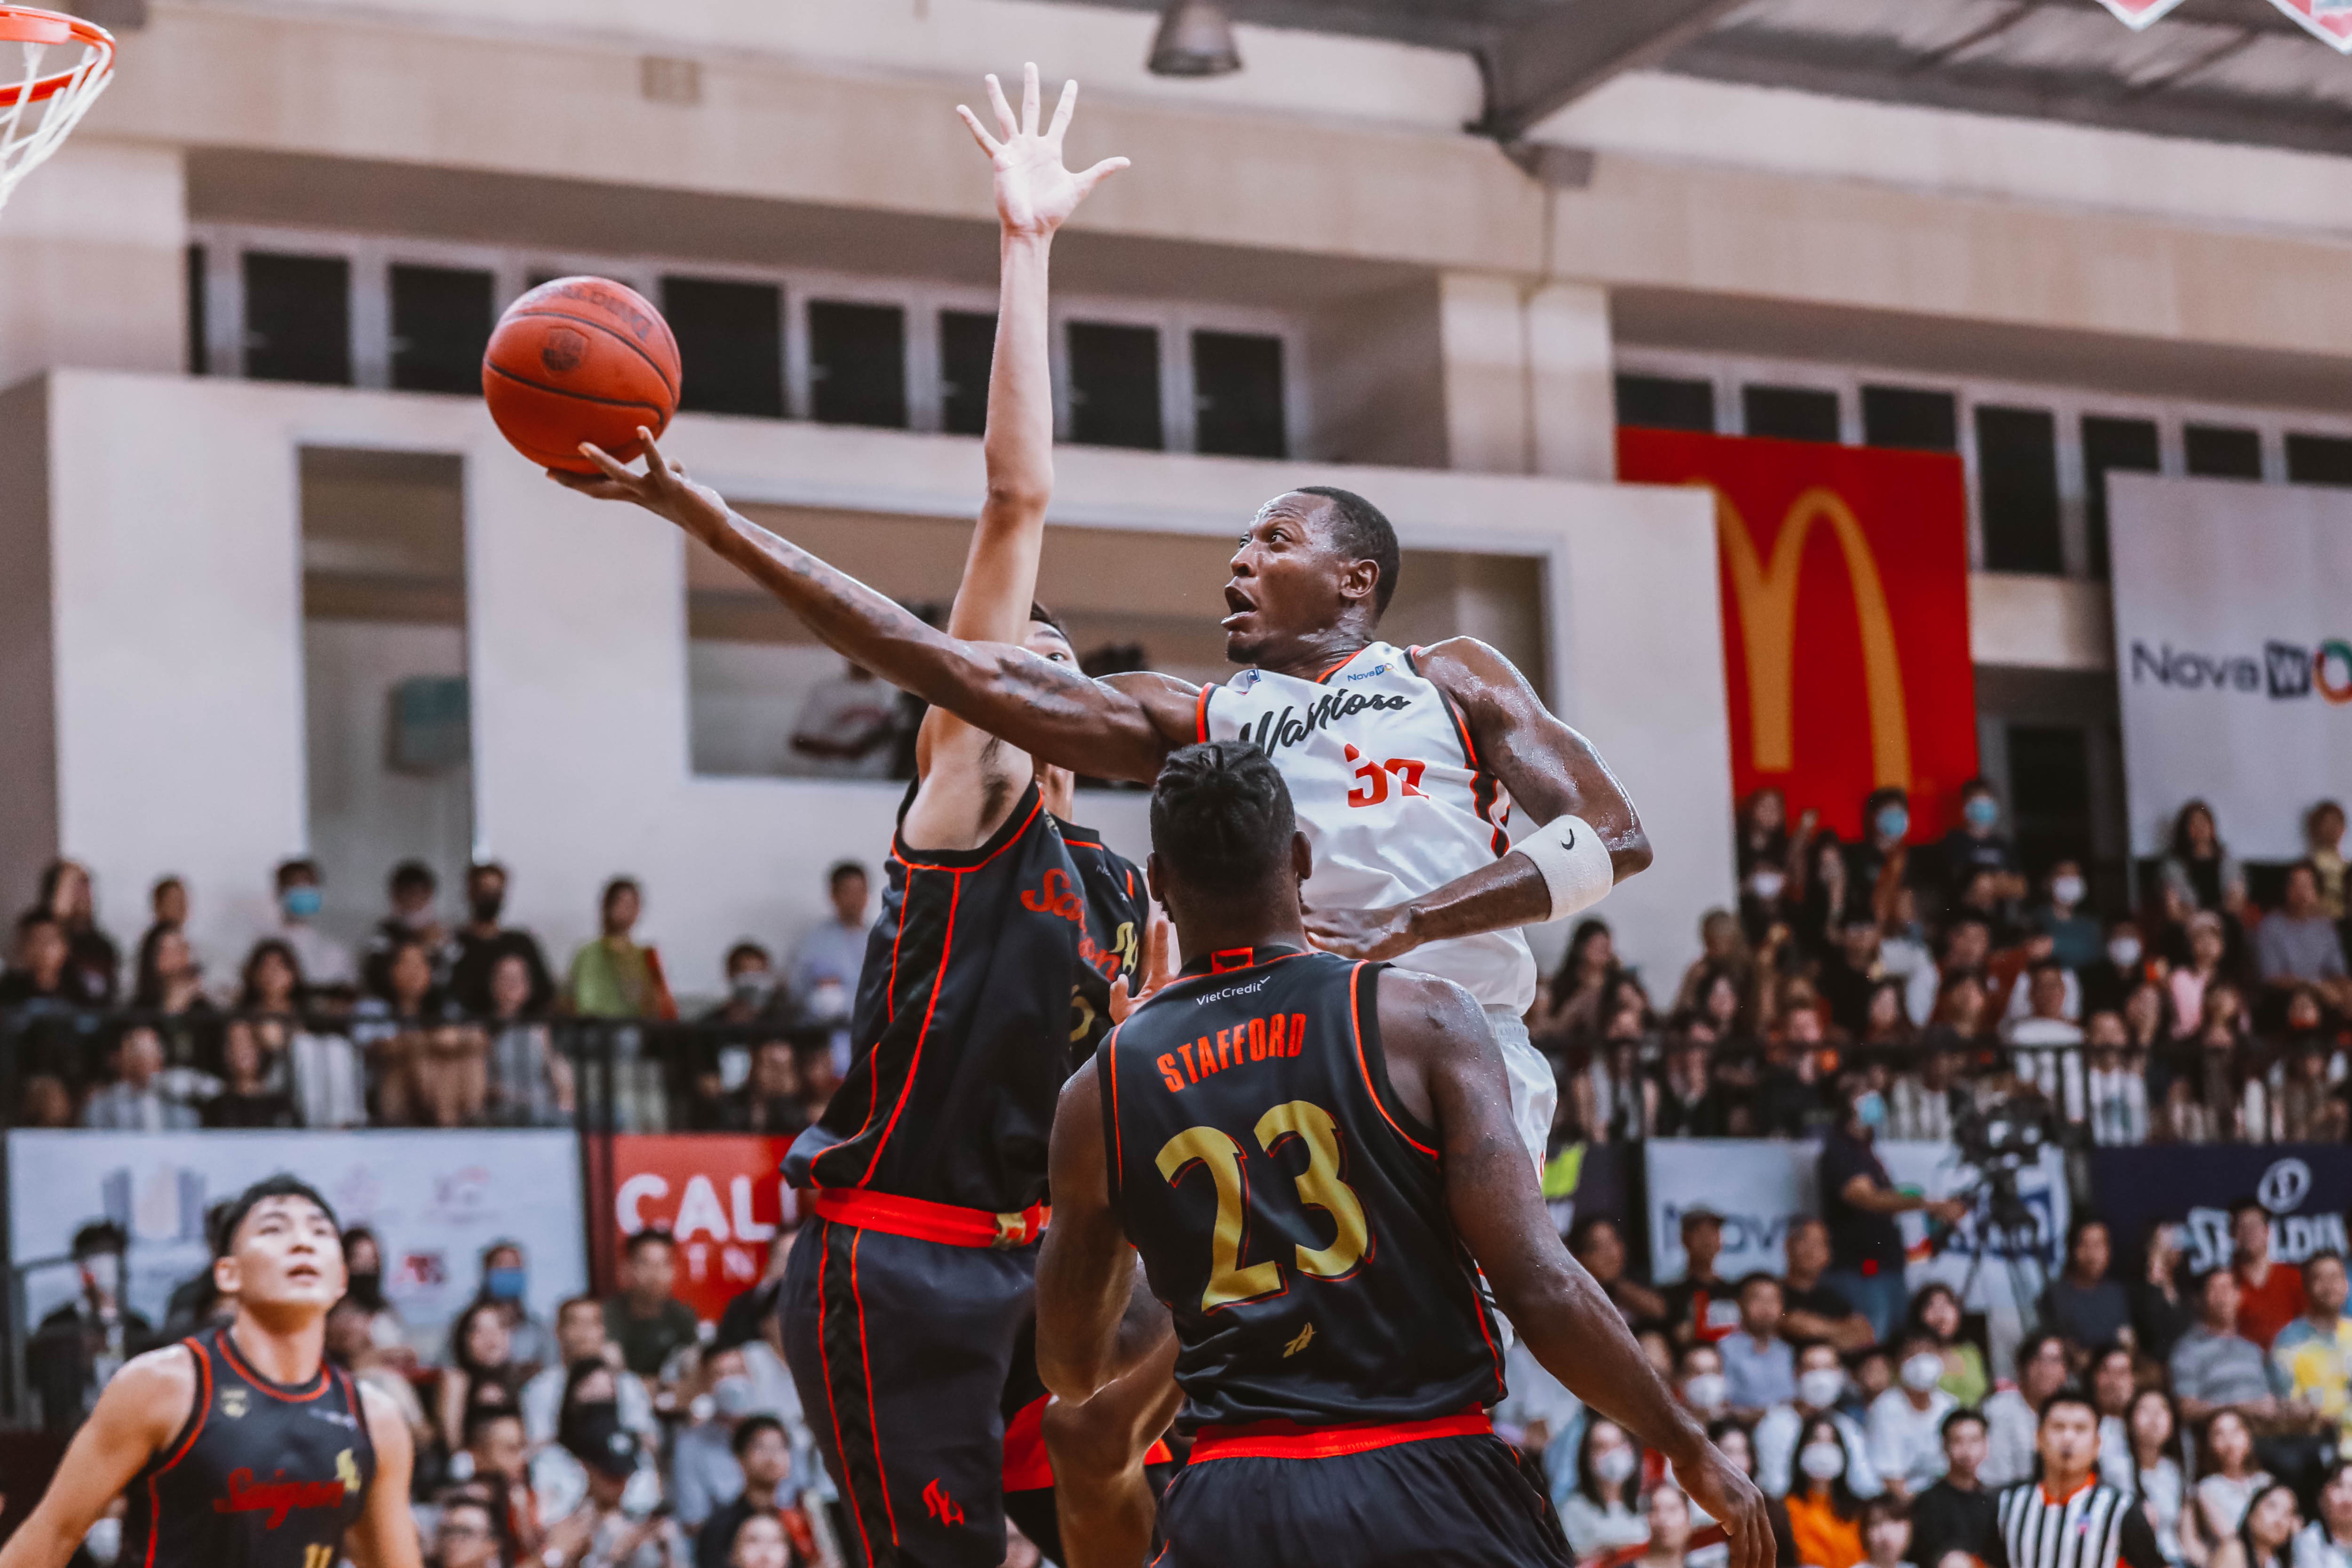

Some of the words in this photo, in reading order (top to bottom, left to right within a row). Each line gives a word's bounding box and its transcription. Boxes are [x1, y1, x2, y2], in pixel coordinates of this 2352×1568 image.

[1196, 983, 1262, 1005] VietCredit
[1157, 1013, 1306, 1093] STAFFORD
[1155, 1100, 1375, 1315] 23
